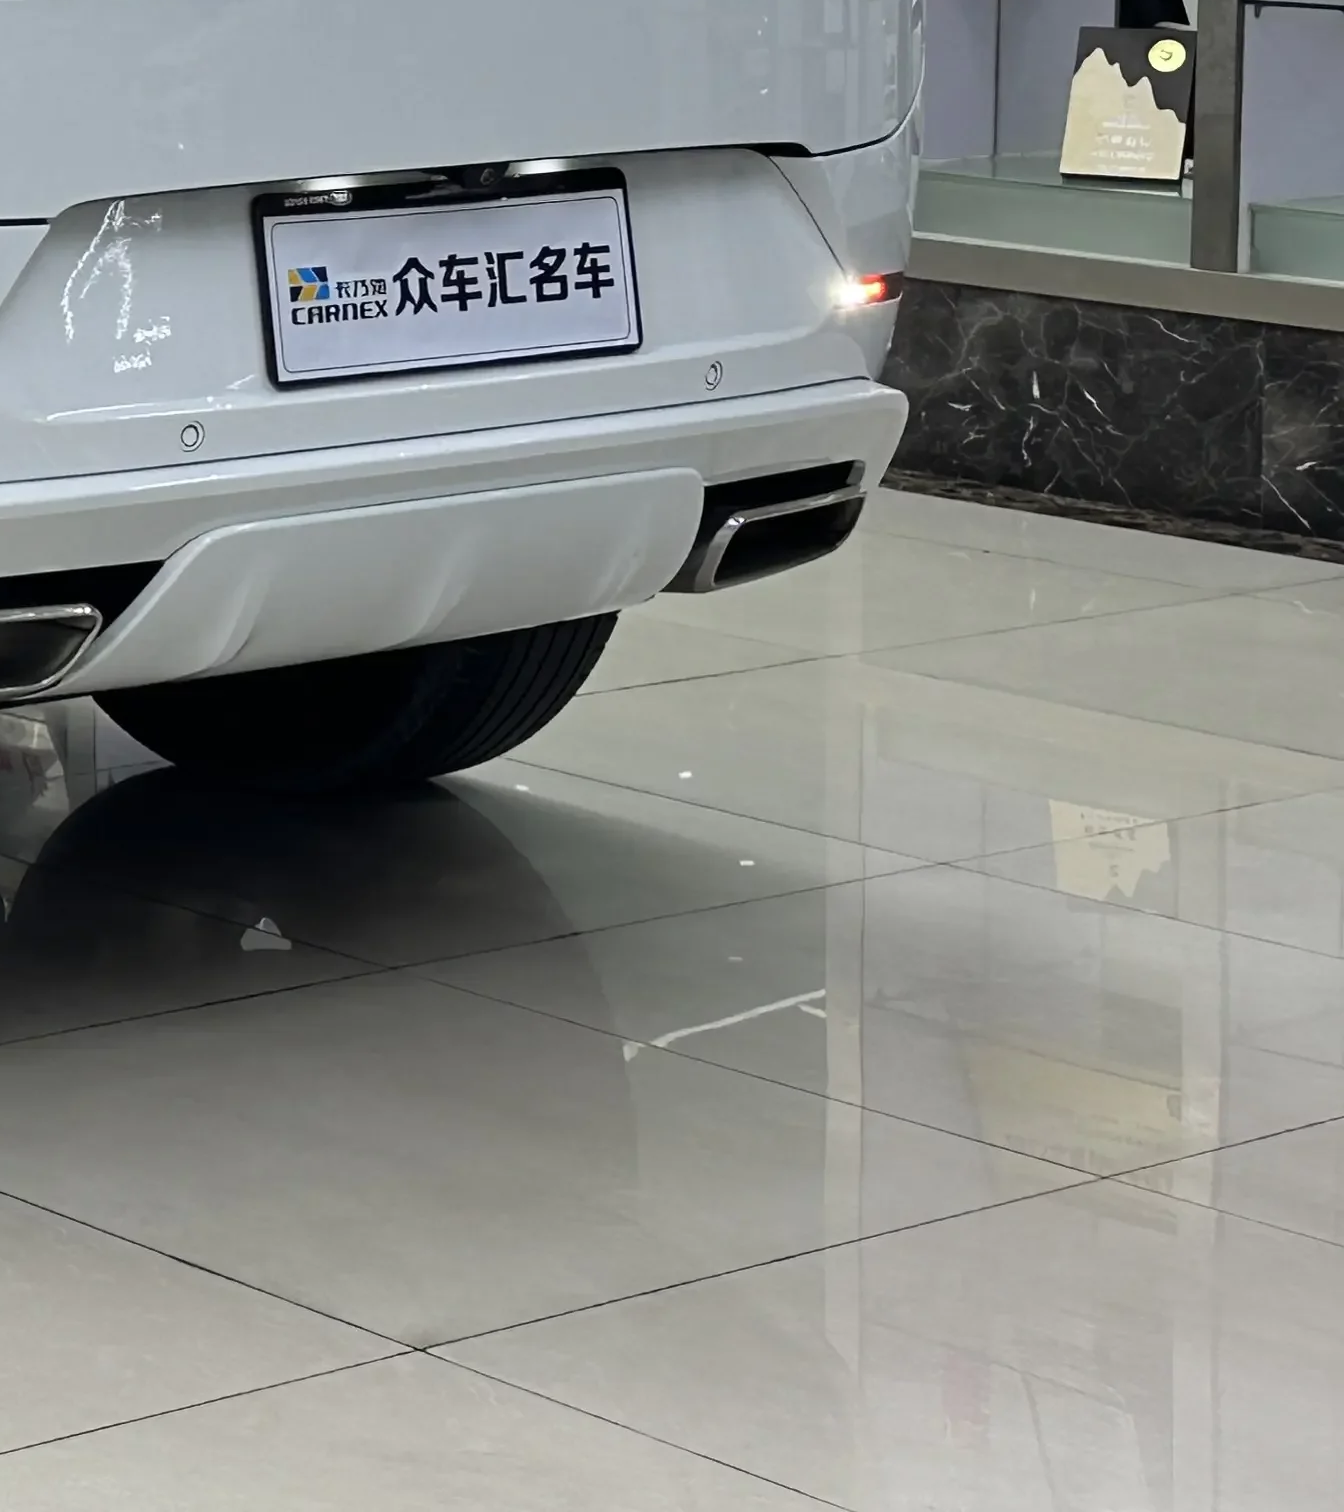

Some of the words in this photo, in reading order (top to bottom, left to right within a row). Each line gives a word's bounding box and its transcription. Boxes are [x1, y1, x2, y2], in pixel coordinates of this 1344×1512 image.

[392, 241, 615, 316] 众车汇名车
[291, 299, 389, 326] CARNEX
